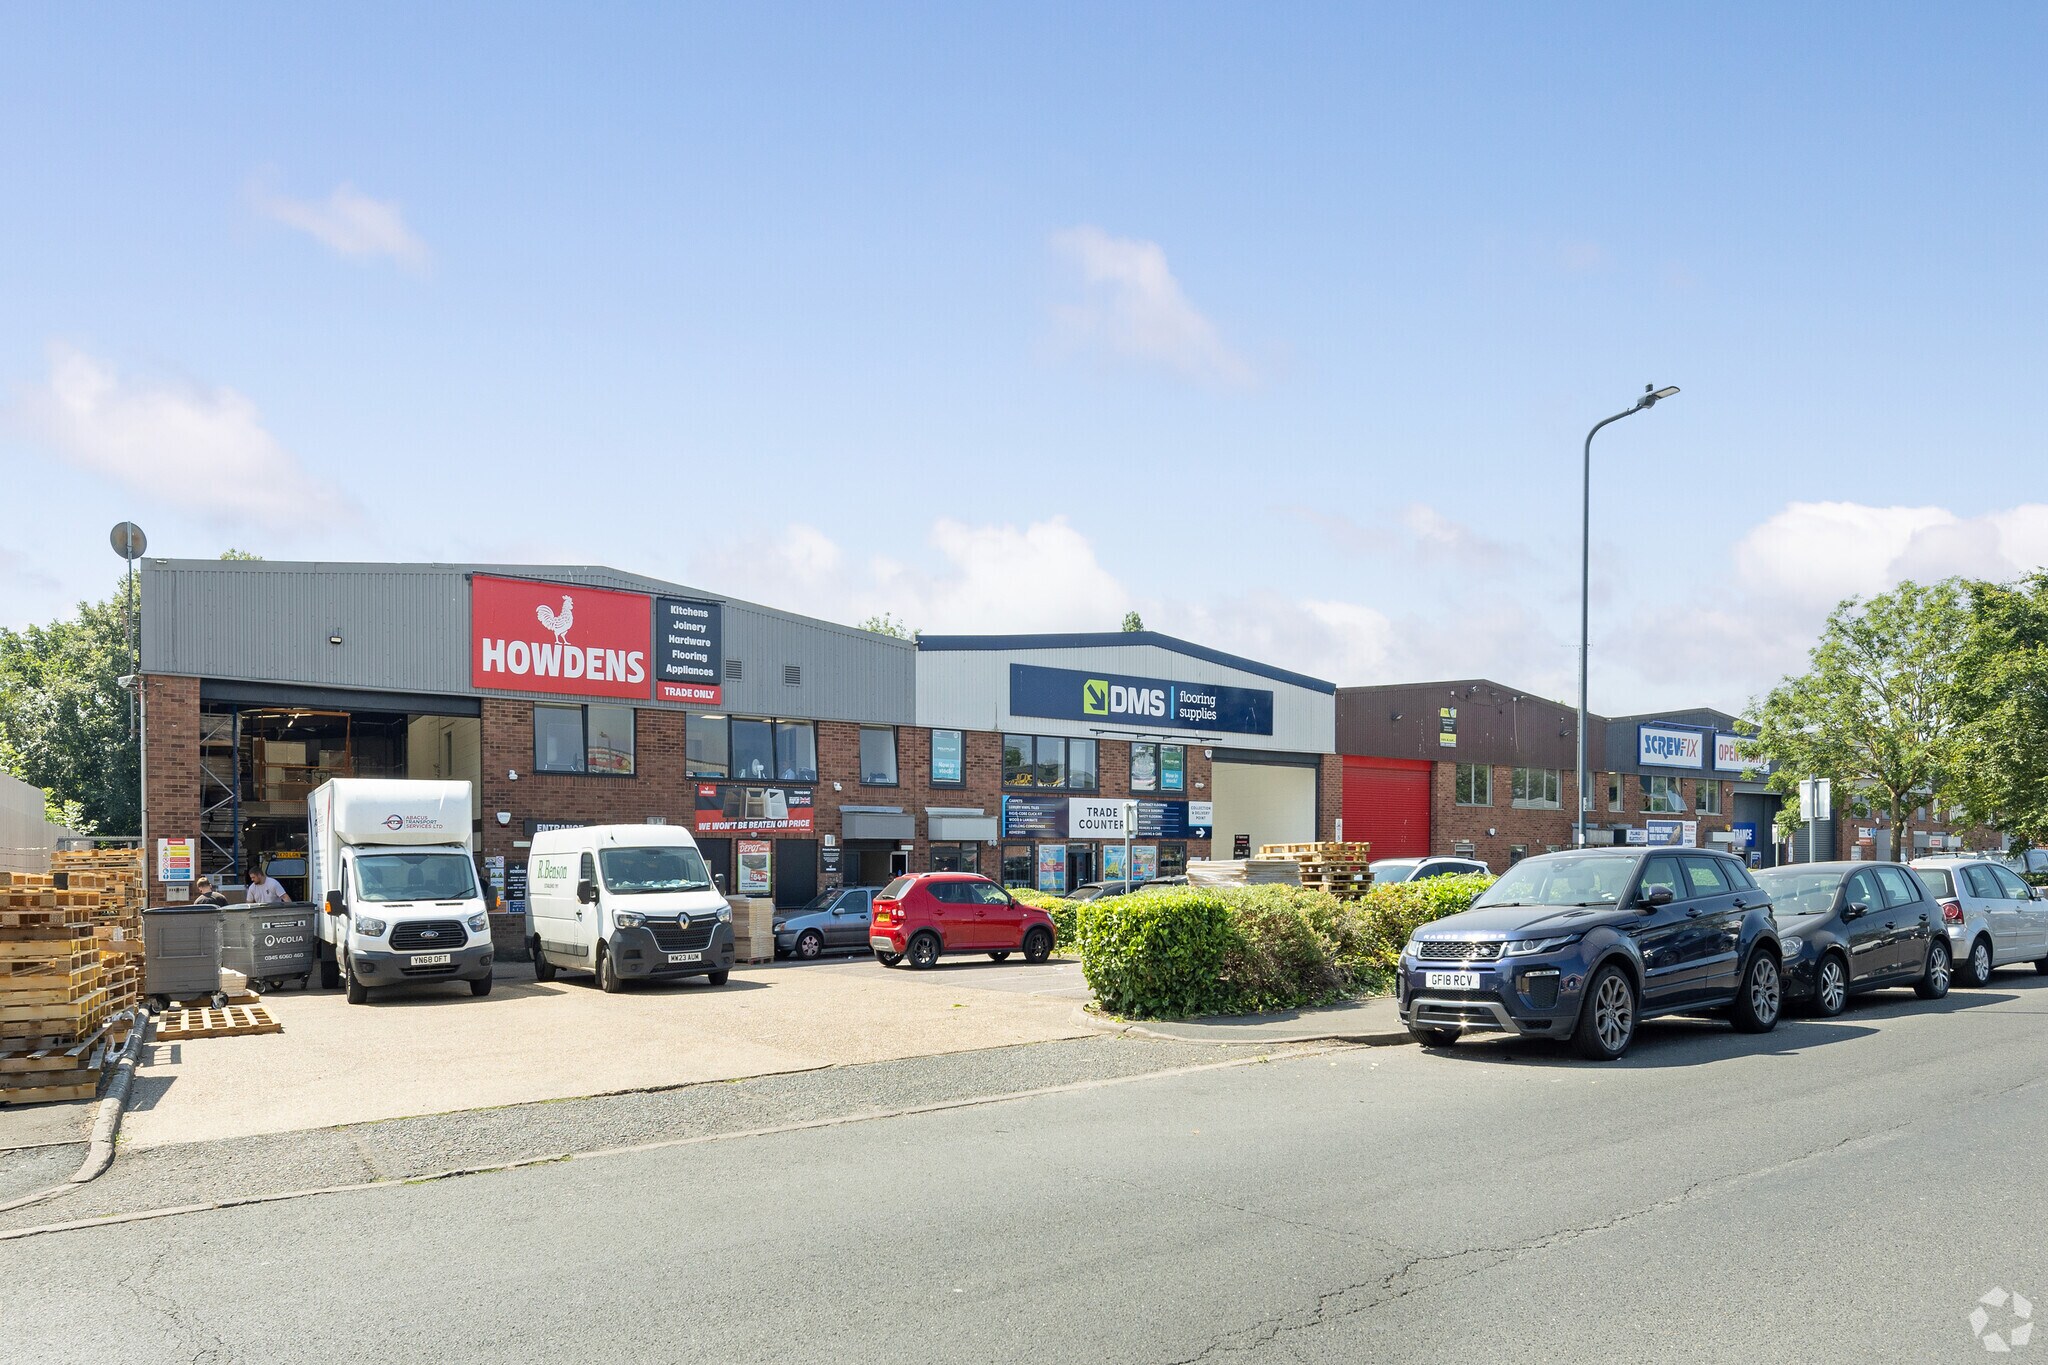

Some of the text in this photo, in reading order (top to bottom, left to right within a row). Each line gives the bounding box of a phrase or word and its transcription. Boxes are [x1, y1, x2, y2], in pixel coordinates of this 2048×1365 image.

[670, 605, 709, 618] Kitchens
[673, 621, 706, 634] Joinery
[668, 635, 711, 647] Hardware
[482, 638, 646, 684] HOWDENS
[672, 650, 708, 663] Flooring
[666, 663, 714, 677] Appliances
[664, 686, 715, 700] TRADE ONLY
[1179, 690, 1217, 708] flooring
[1110, 685, 1165, 717] DMS
[1179, 707, 1217, 721] supplies
[1644, 734, 1699, 760] SCREWFIX
[1086, 807, 1118, 817] TRADE
[698, 819, 810, 831] WE WON'T BE BEATEN ON PRICE
[1078, 819, 1124, 830] COUNTER
[1733, 828, 1753, 840] TRANCE
[739, 844, 761, 853] DEPOT
[537, 859, 568, 879] R.Benson
[275, 935, 304, 944] VEOLIA
[413, 956, 433, 964] YN68
[1431, 974, 1473, 987] GF18 RCV
